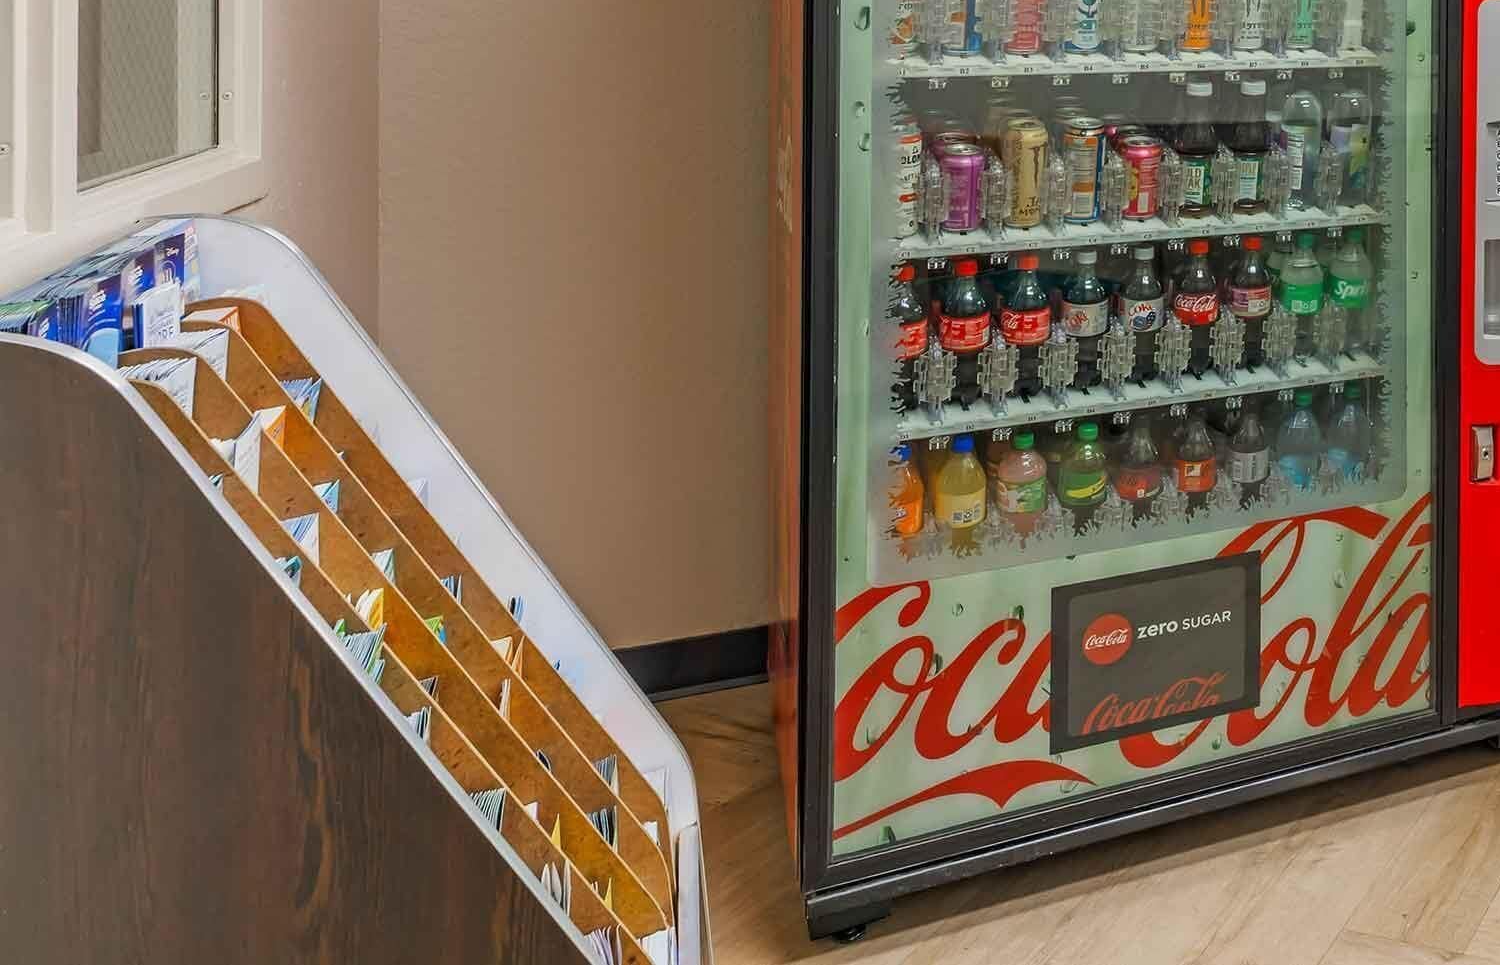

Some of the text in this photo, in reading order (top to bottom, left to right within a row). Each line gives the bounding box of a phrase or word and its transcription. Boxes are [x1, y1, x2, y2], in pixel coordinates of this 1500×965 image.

[1175, 293, 1217, 313] Coca-Cola
[1082, 609, 1231, 651] Coca-Cola zero SUGAR
